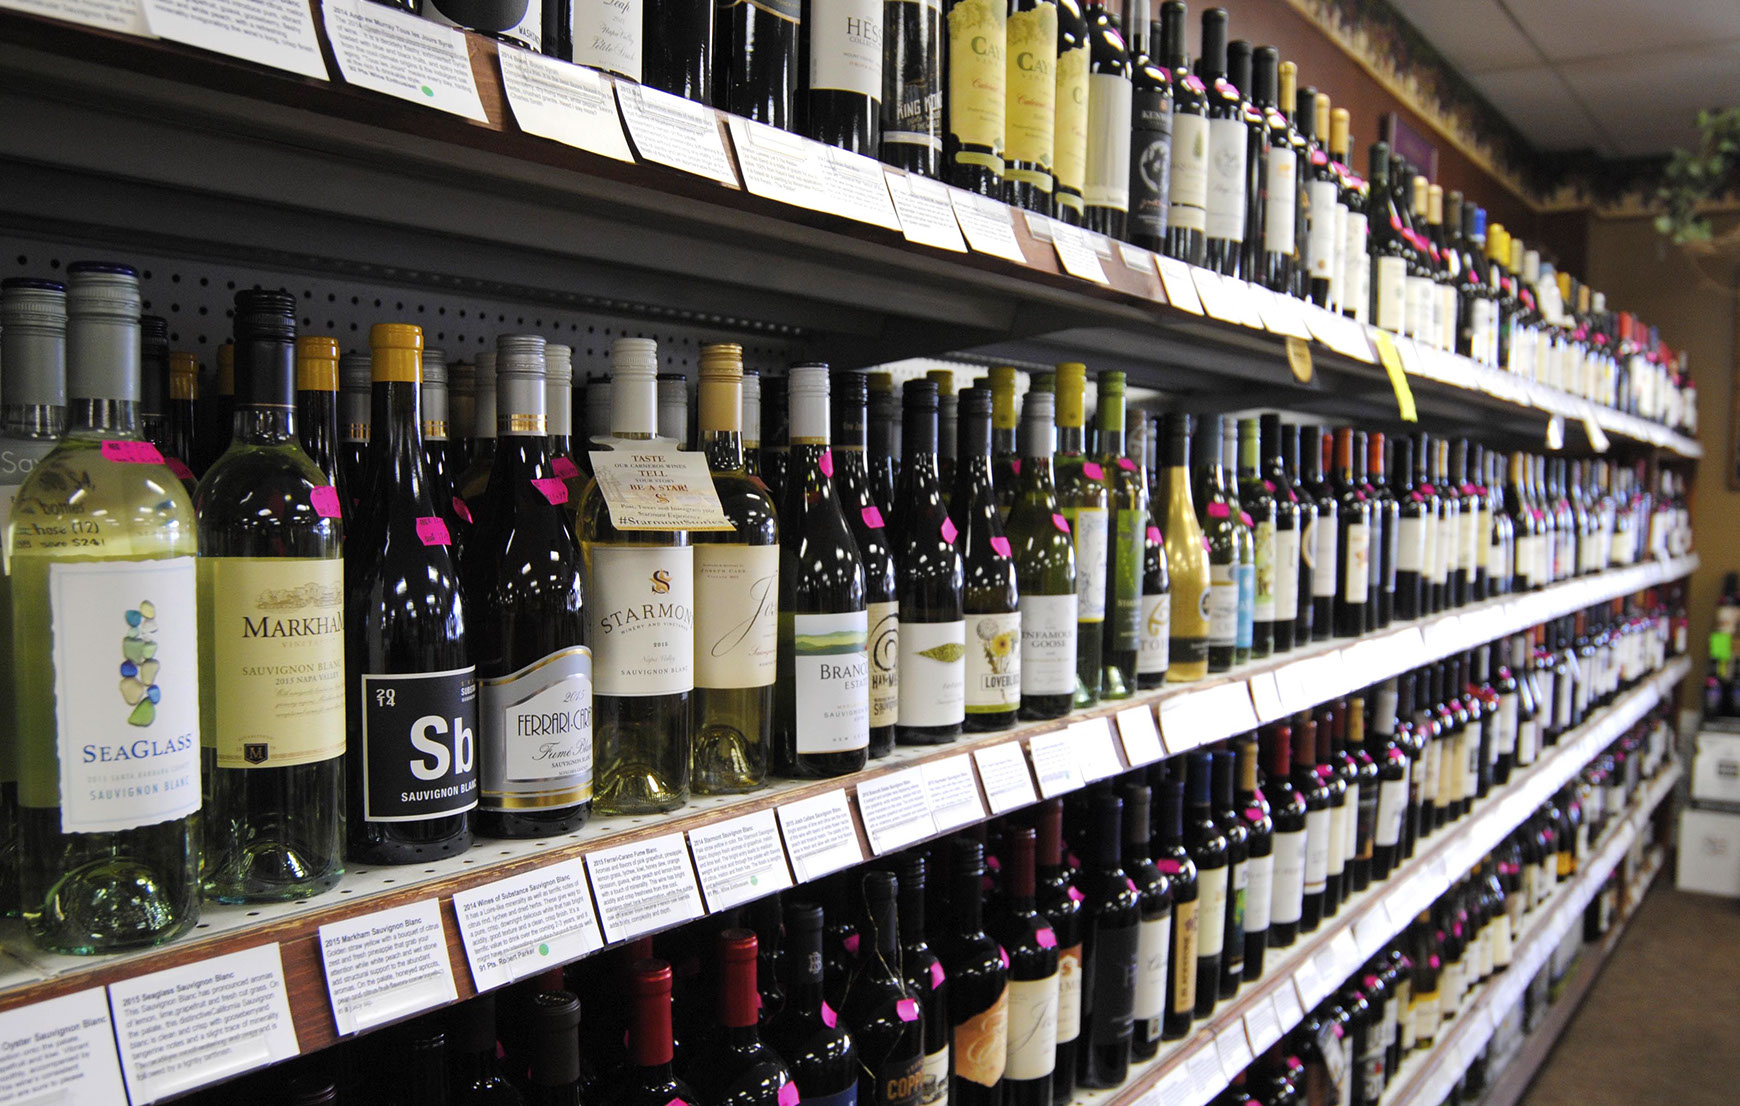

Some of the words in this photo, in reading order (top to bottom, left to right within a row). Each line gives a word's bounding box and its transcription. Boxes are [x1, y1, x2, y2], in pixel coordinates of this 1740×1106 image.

[619, 517, 725, 525] #StarmontStories
[620, 625, 644, 635] WINERY
[242, 663, 314, 676] SAUVIGNON
[621, 668, 668, 676] SAUVIGNON
[275, 678, 295, 686] 2015
[376, 689, 395, 698] 20
[377, 697, 395, 707] 14
[410, 715, 473, 780] Sb
[552, 757, 580, 768] SAUVIGNON
[90, 784, 158, 801] SAUVIGNON
[164, 776, 189, 791] BLANC
[401, 786, 459, 802] SAUVIGNON
[460, 779, 476, 793] BLANC
[722, 829, 742, 838] Sauvignon
[646, 847, 657, 855] Blanc
[463, 903, 477, 912] 2014
[478, 897, 494, 907] Wines
[501, 886, 529, 899] Substance
[529, 879, 556, 892] Sauvignon
[556, 874, 571, 883] Blanc
[325, 940, 340, 948] 2015
[341, 931, 370, 943] Markham
[371, 922, 404, 935] Sauvignon
[404, 918, 422, 927] Blanc
[326, 946, 346, 957] Golden
[348, 943, 362, 952] straw
[364, 939, 380, 949] yellow
[381, 935, 391, 943] with
[398, 929, 419, 939] bouquet
[426, 923, 439, 931] citrus
[353, 951, 366, 959] fresh
[368, 945, 393, 957] pineapple
[405, 938, 417, 947] grab
[418, 935, 429, 944] your
[330, 965, 354, 976] attention
[355, 961, 369, 969] while
[371, 957, 384, 965] white
[385, 952, 401, 962] peach
[402, 949, 412, 957] and
[423, 942, 437, 950] stone
[479, 964, 487, 972] 91
[487, 961, 497, 969] Pts.
[517, 948, 535, 959] Parker
[123, 996, 140, 1007] 2015
[142, 987, 175, 1001] Seaglass
[176, 977, 214, 992] Sauvignon
[215, 972, 235, 982] Blanc
[124, 1008, 139, 1017] This
[141, 997, 177, 1012] Sauvignon
[178, 992, 197, 1003] Blanc
[198, 989, 210, 997] has
[211, 978, 250, 995] pronounced
[251, 972, 273, 983] aromas
[2, 1037, 31, 1051] Oyster
[34, 1024, 80, 1041] Sauvignon
[82, 1016, 107, 1028] Blanc
